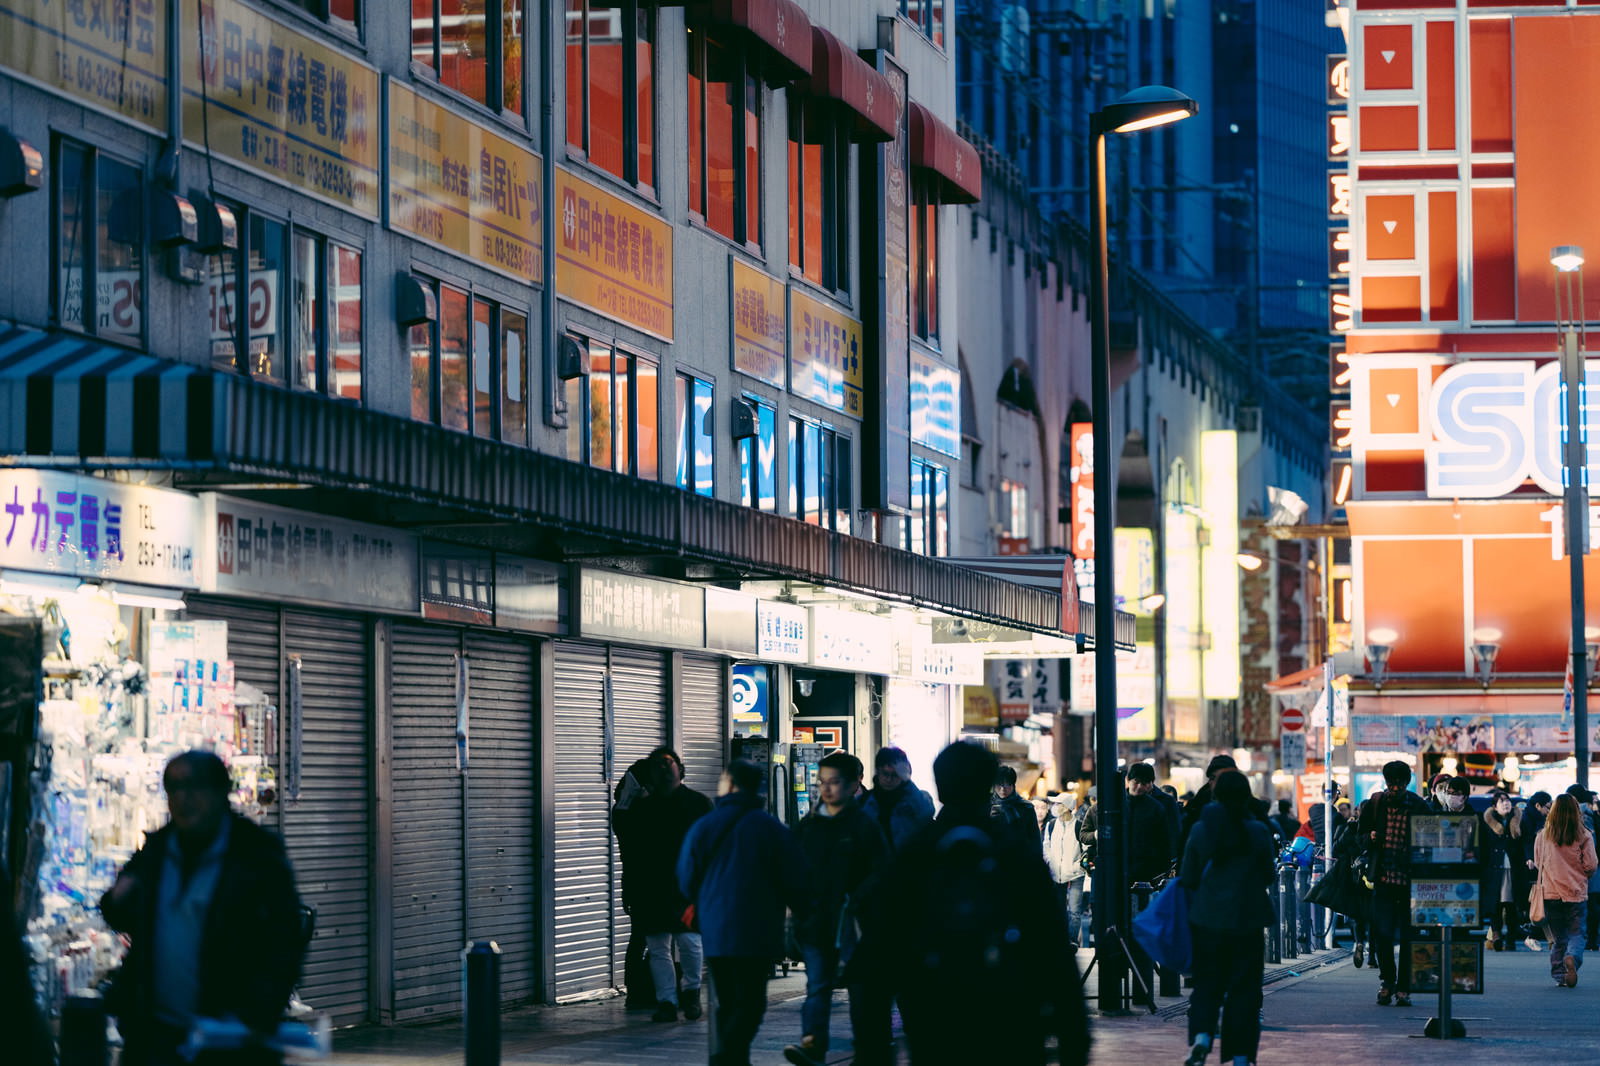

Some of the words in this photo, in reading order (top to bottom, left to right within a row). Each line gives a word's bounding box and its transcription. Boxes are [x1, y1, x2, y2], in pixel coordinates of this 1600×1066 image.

[291, 151, 305, 177] TEL
[482, 234, 495, 258] TEL
[138, 504, 155, 530] TEL
